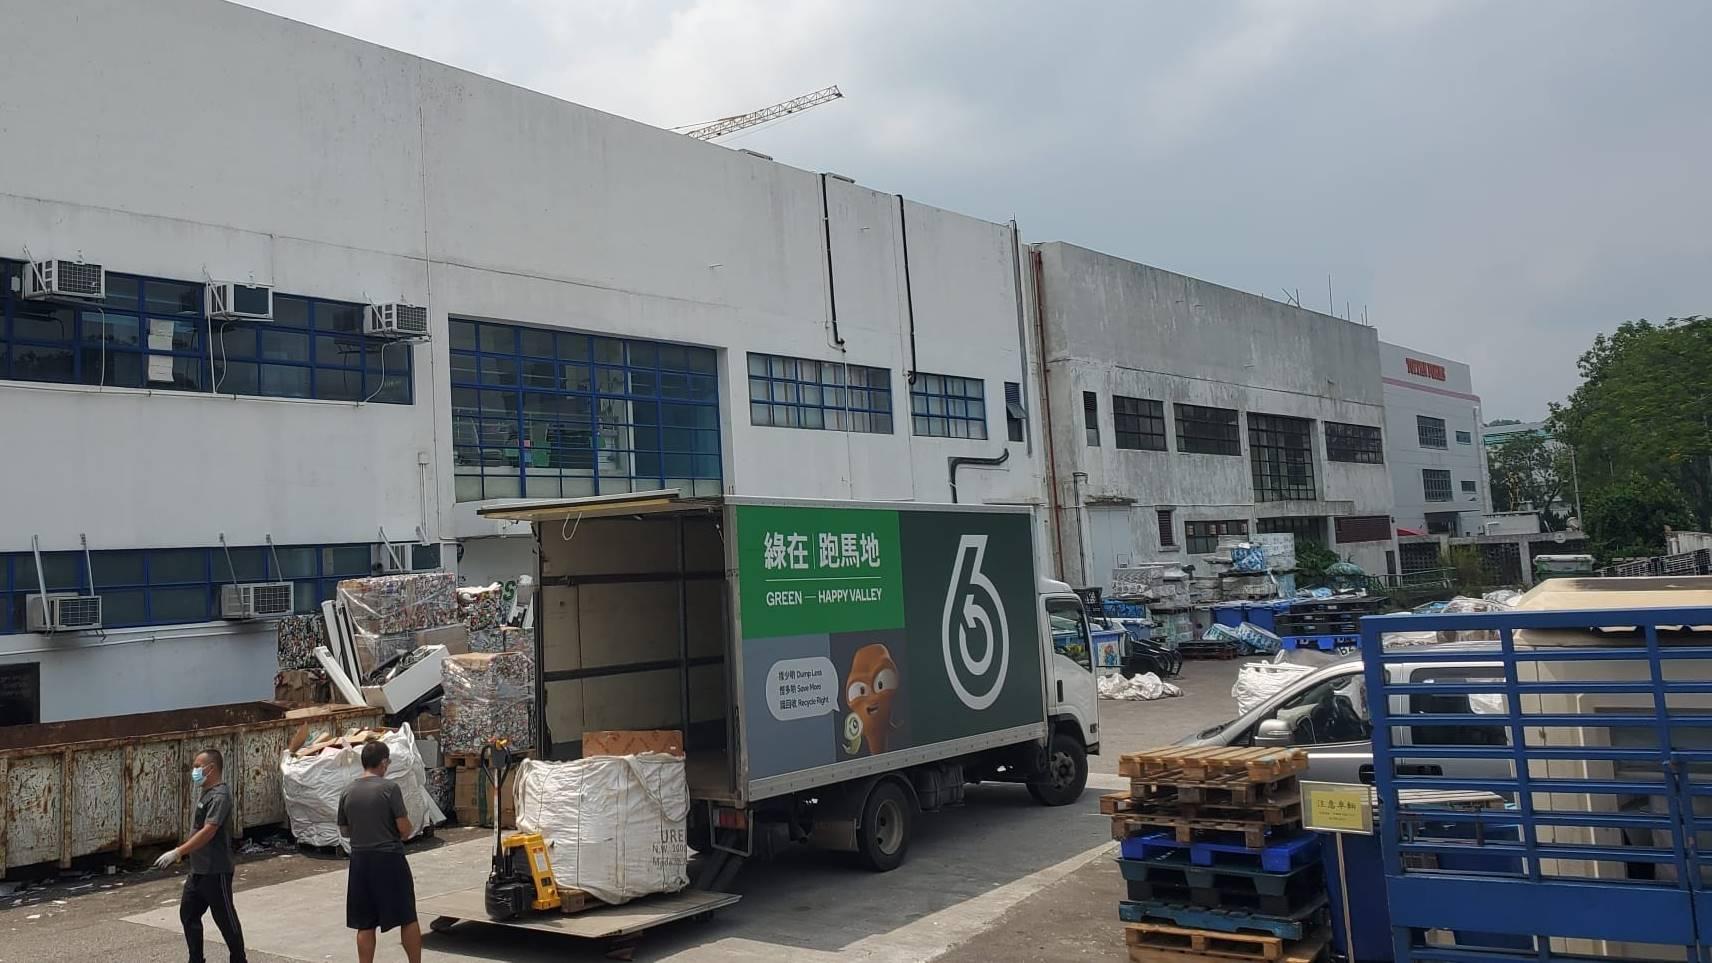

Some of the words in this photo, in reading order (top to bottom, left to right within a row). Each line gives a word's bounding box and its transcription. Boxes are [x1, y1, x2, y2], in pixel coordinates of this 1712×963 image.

[764, 532, 809, 570] 綠在
[818, 532, 881, 569] 跑馬地
[766, 591, 803, 606] GREEN
[818, 589, 849, 604] HAPPY
[850, 587, 883, 602] VALLEY
